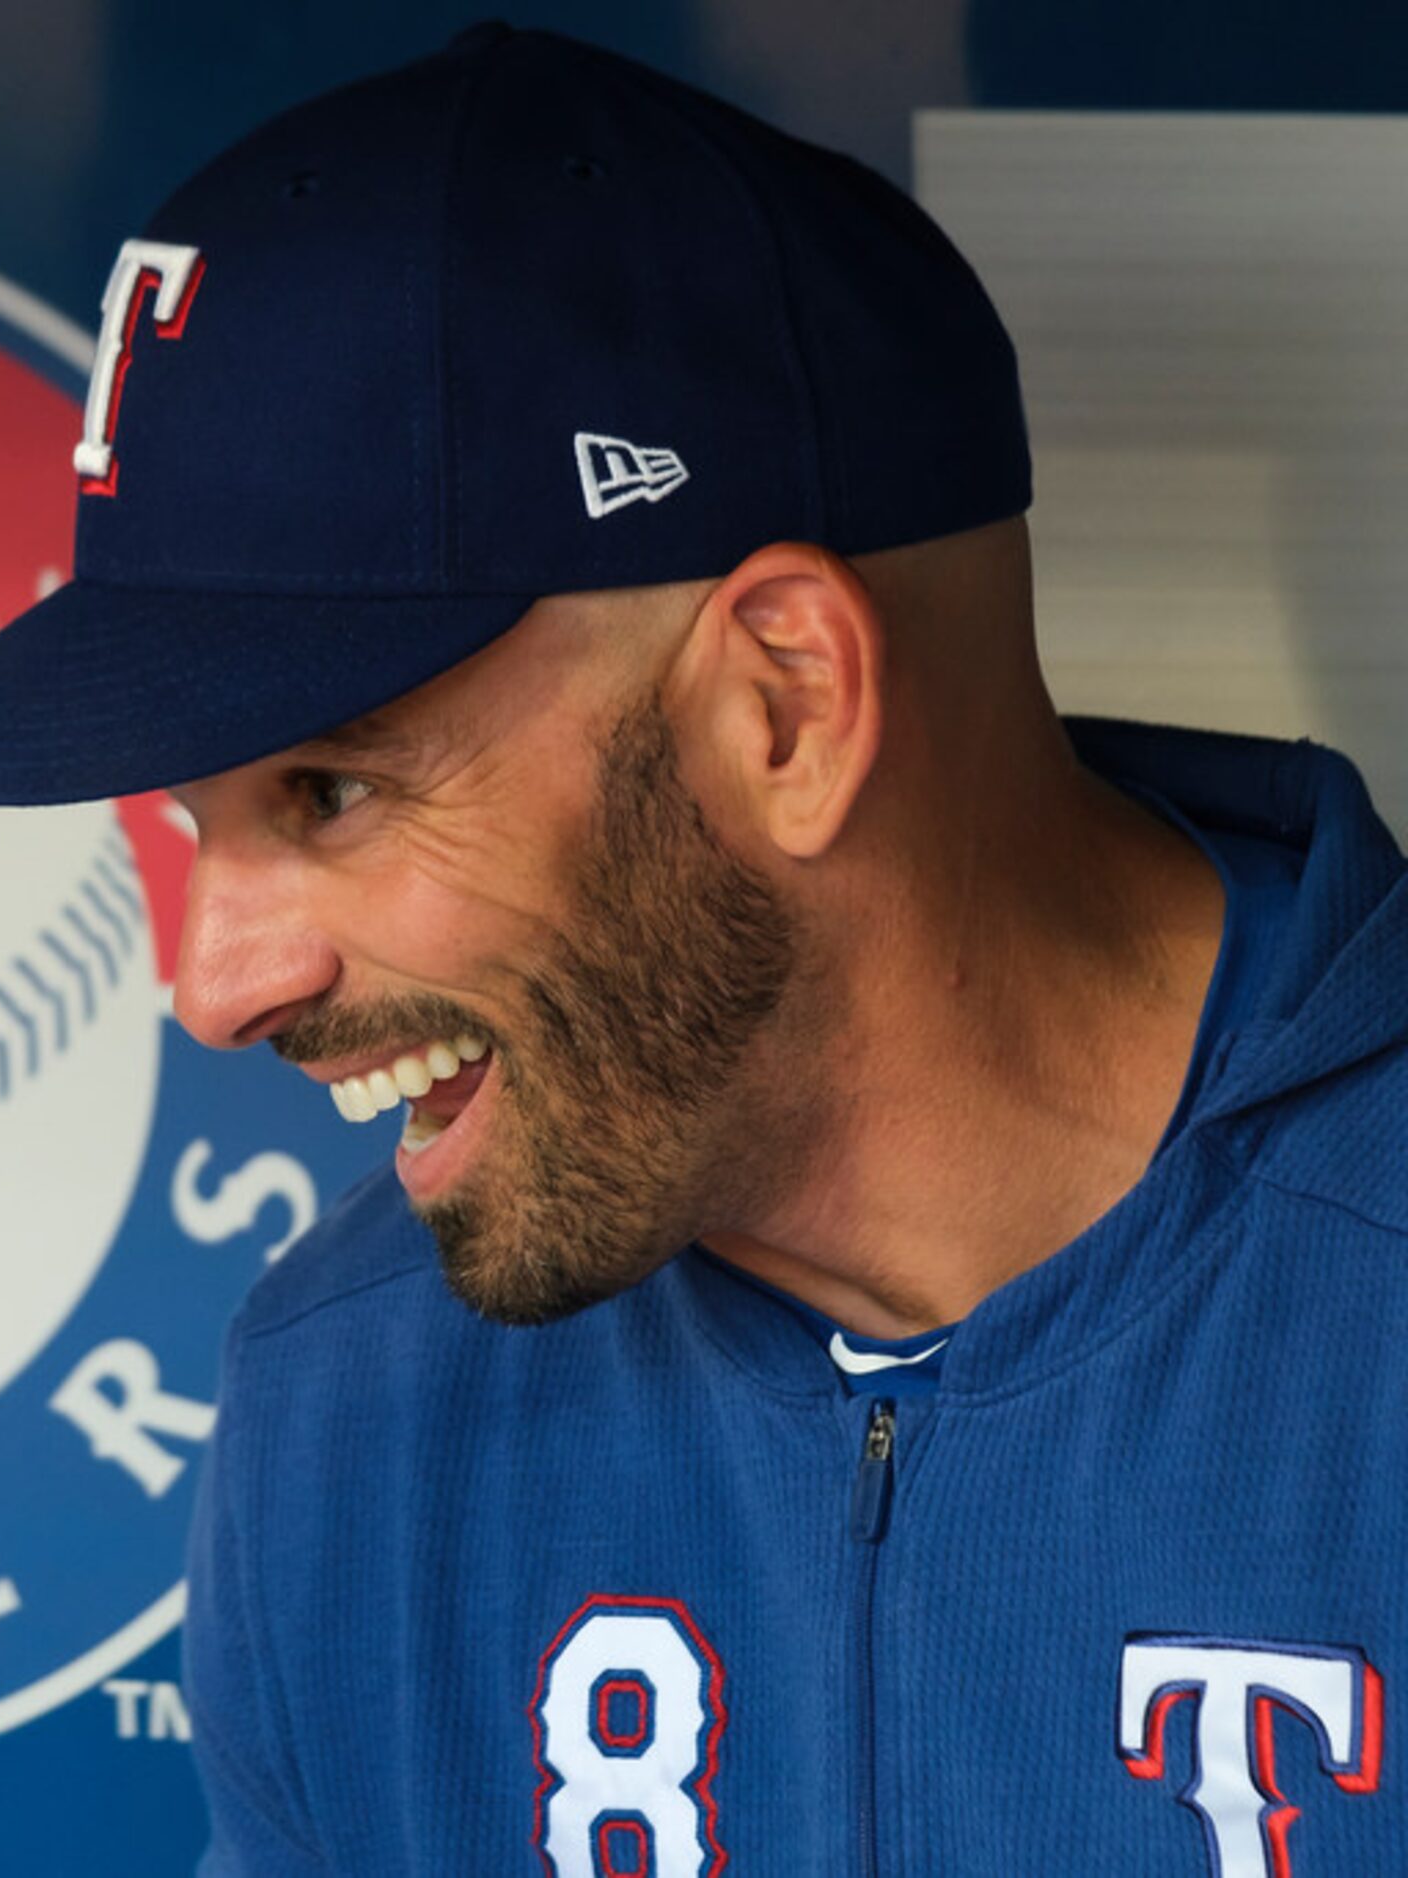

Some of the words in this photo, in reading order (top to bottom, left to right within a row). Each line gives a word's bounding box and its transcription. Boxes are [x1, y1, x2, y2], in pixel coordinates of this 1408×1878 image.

[73, 238, 206, 497] T
[526, 1593, 729, 1878] 8
[1113, 1631, 1385, 1878] T
